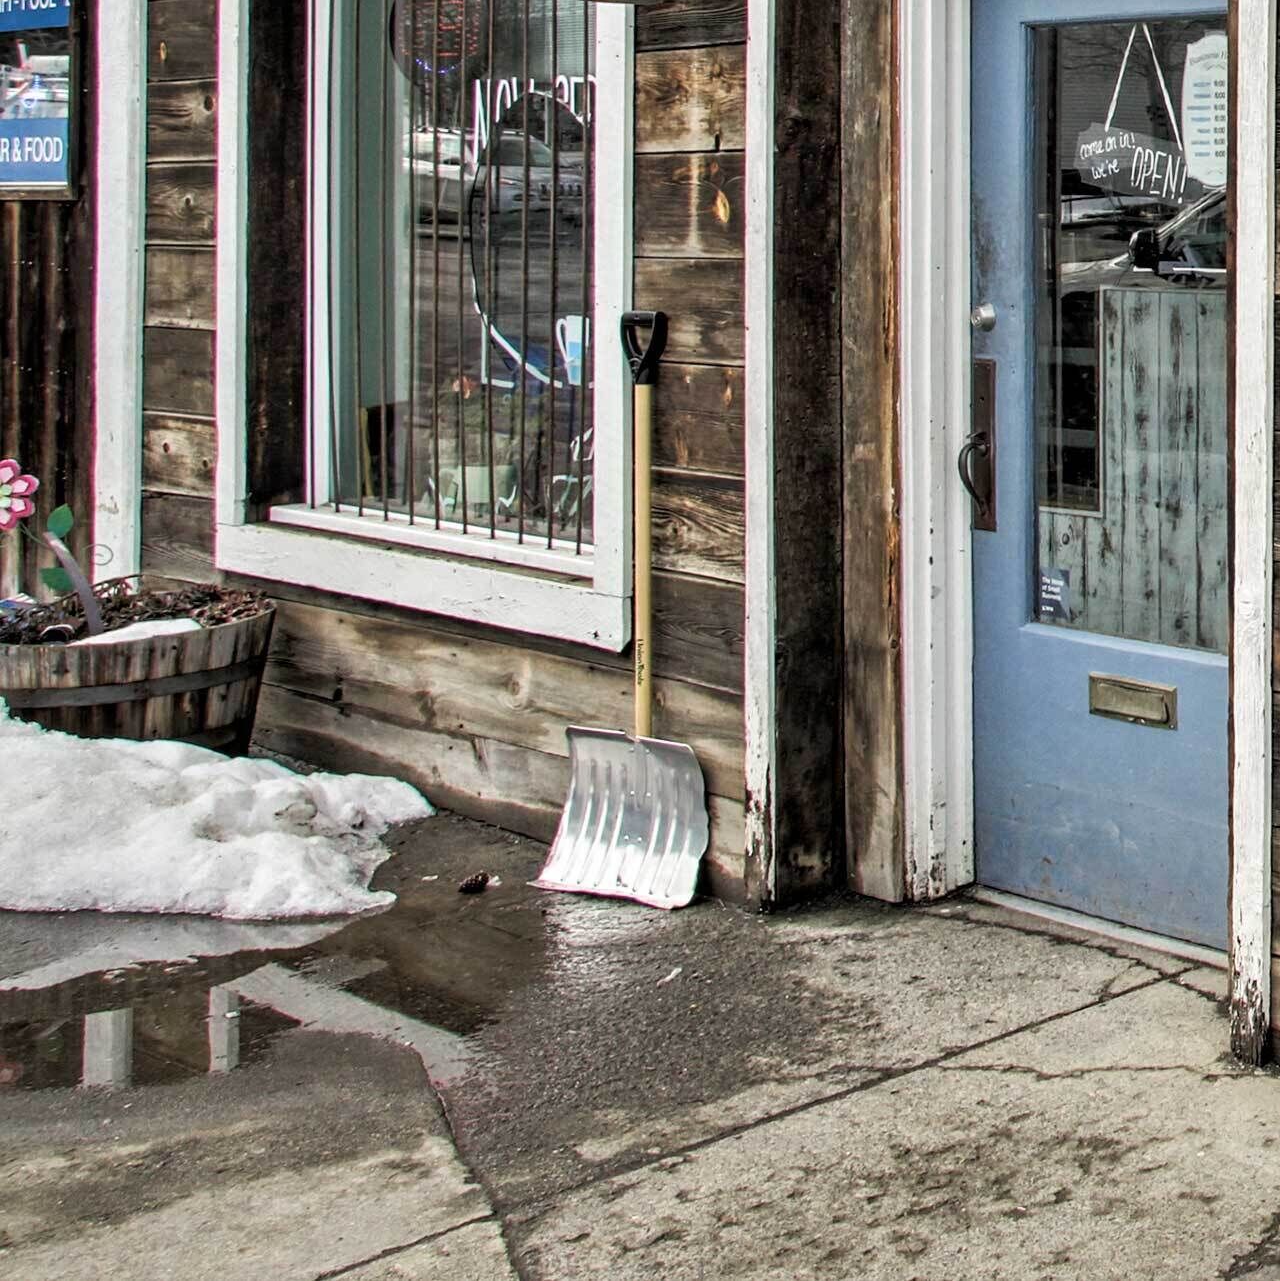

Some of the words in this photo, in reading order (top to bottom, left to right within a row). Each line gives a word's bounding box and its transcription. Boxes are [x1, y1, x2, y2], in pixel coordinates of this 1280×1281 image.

[13, 137, 22, 162] &
[24, 136, 63, 162] FOOD
[1080, 140, 1104, 160] come
[1105, 136, 1118, 153] on
[1119, 131, 1136, 149] in!
[1091, 158, 1120, 179] we're
[1130, 146, 1187, 204] OPEN!
